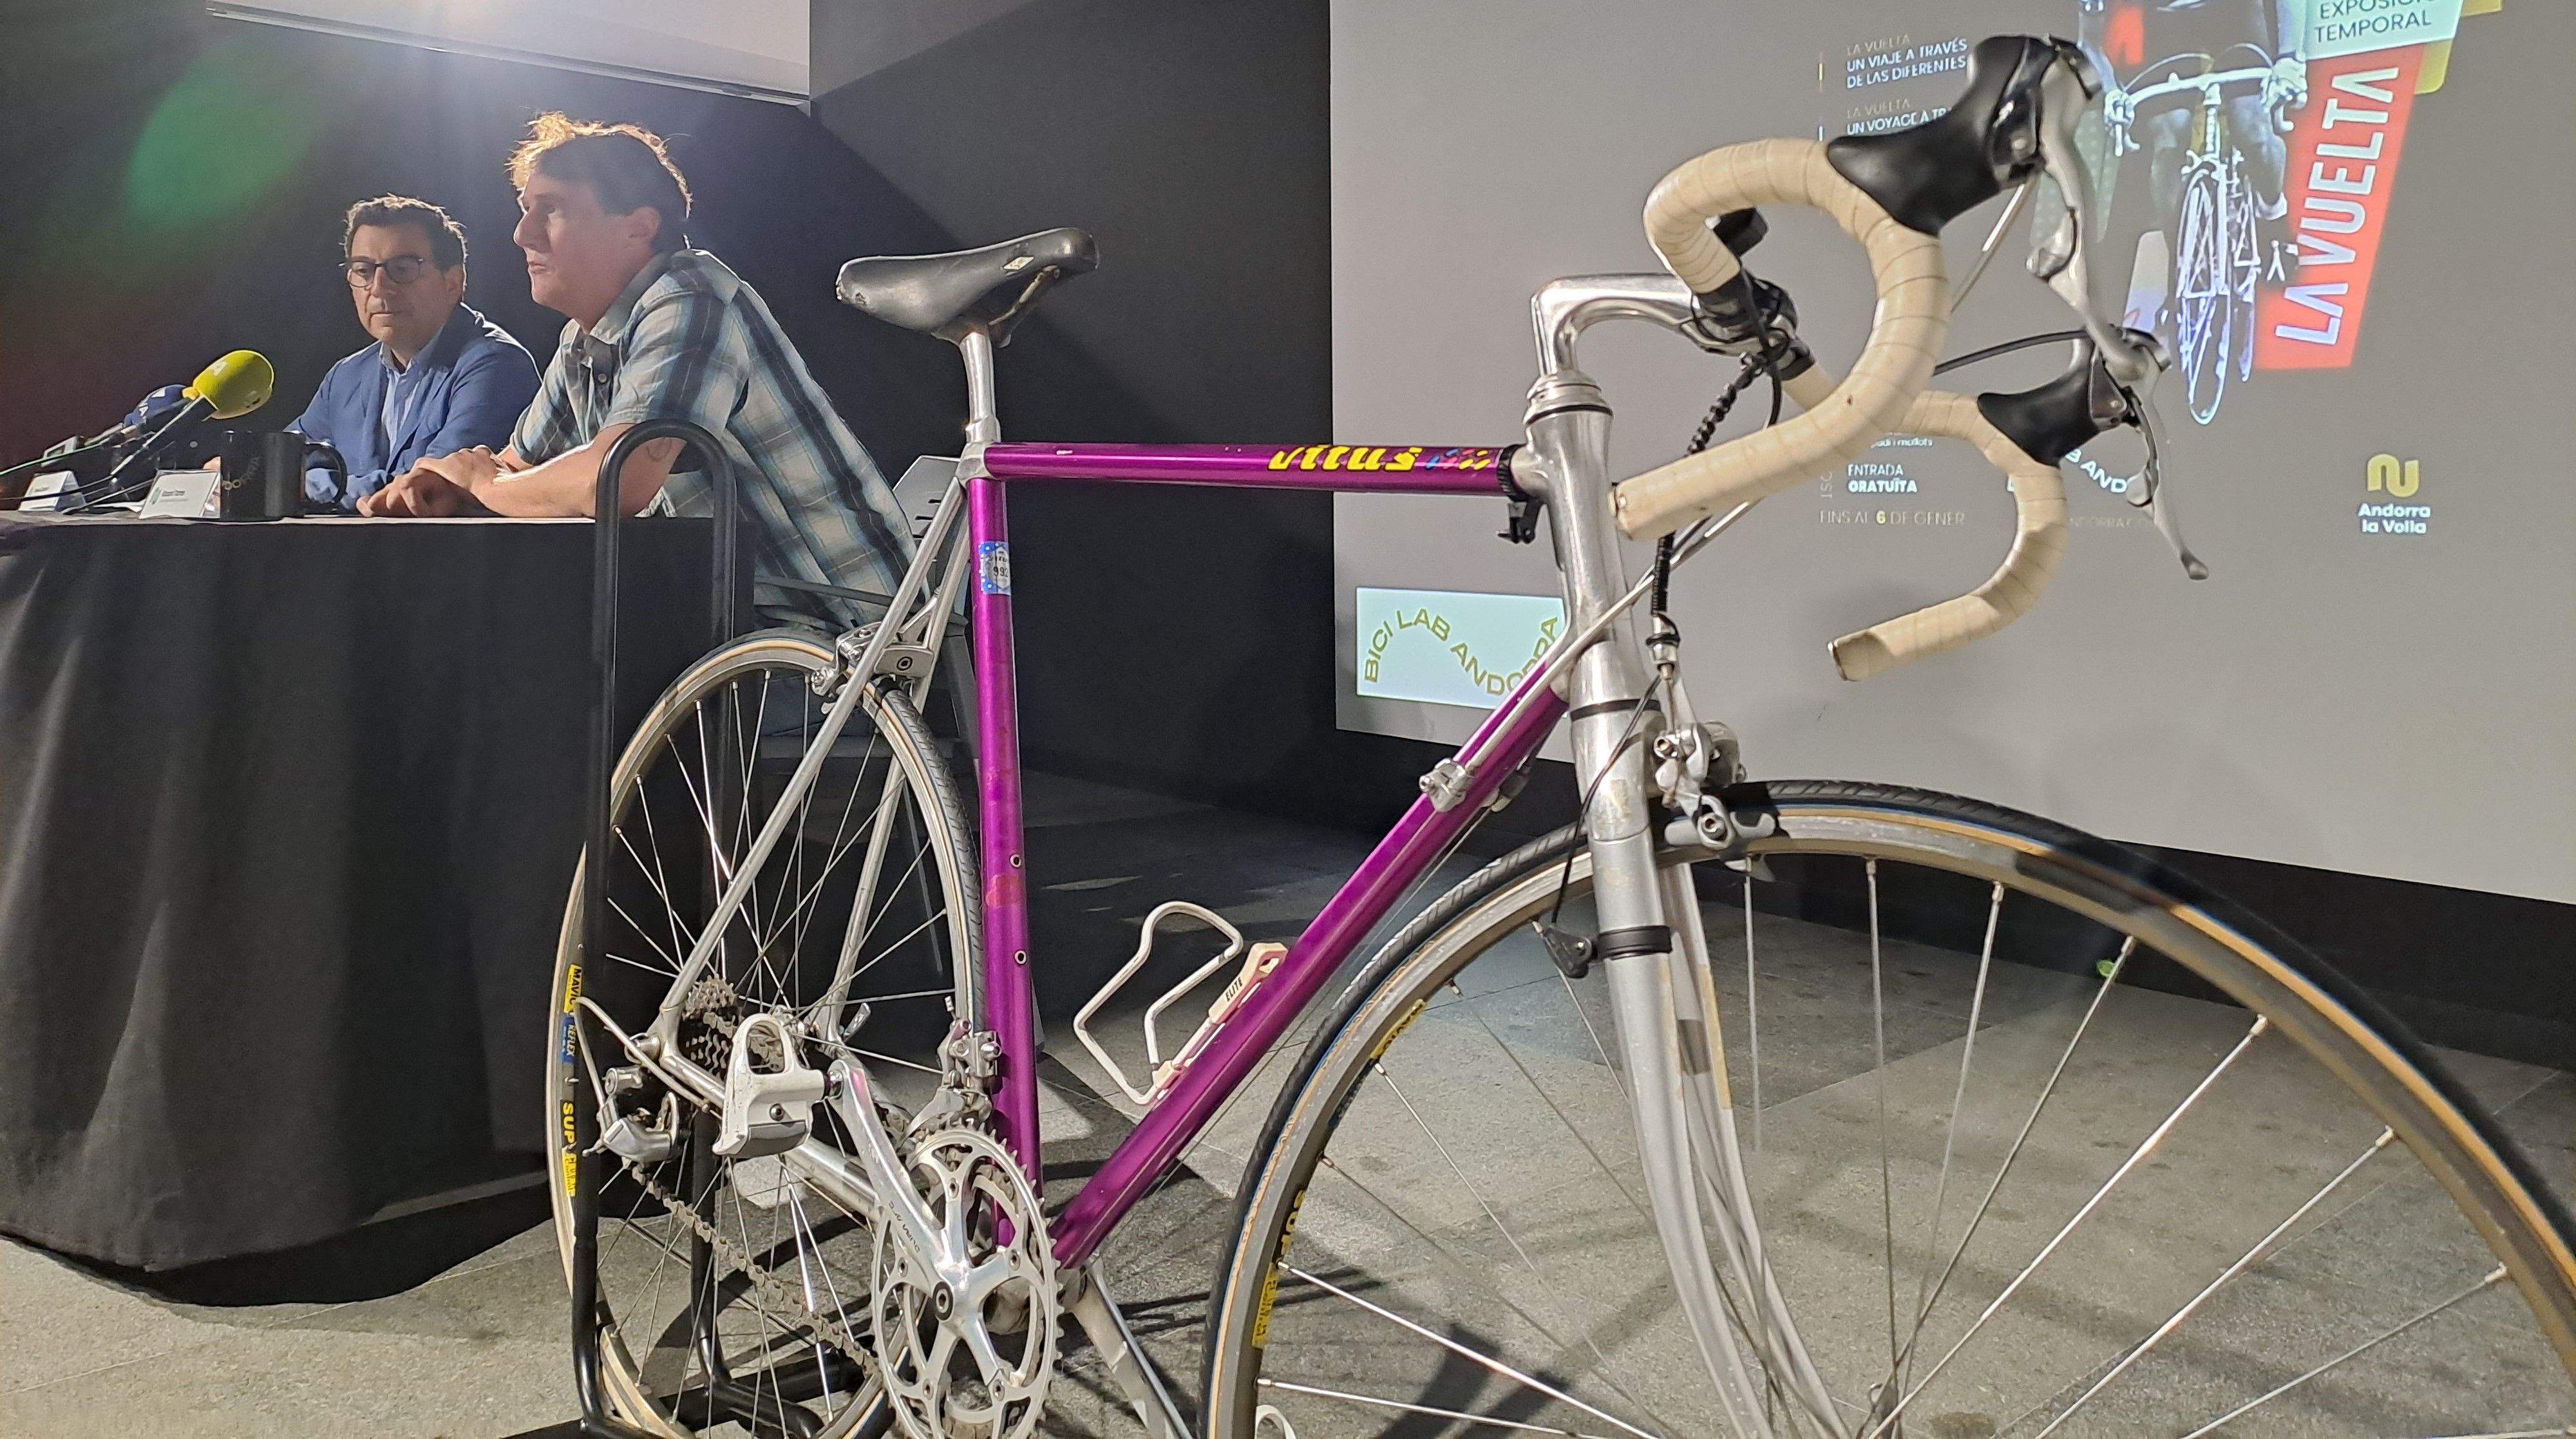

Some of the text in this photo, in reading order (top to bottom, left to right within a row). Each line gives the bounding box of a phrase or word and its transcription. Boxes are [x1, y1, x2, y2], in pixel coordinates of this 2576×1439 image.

[2315, 10, 2432, 43] TEMPORAL
[1847, 37, 1967, 72] UN VIAJE A TRAVÉS
[1847, 55, 1966, 88] DE LAS DIFERENTES
[1847, 122, 1864, 136] UN
[2274, 66, 2399, 346] LA VUELTA
[1268, 444, 1423, 471] vitus
[1848, 464, 1904, 476] ENTRADA
[1876, 511, 1886, 524] 6
[2358, 503, 2431, 518] Andorra
[2362, 519, 2378, 532] la
[1364, 620, 1394, 682] BICI
[1397, 608, 1450, 641] LAB
[1226, 977, 1243, 1002] ELITE
[563, 1102, 575, 1143] SUP
